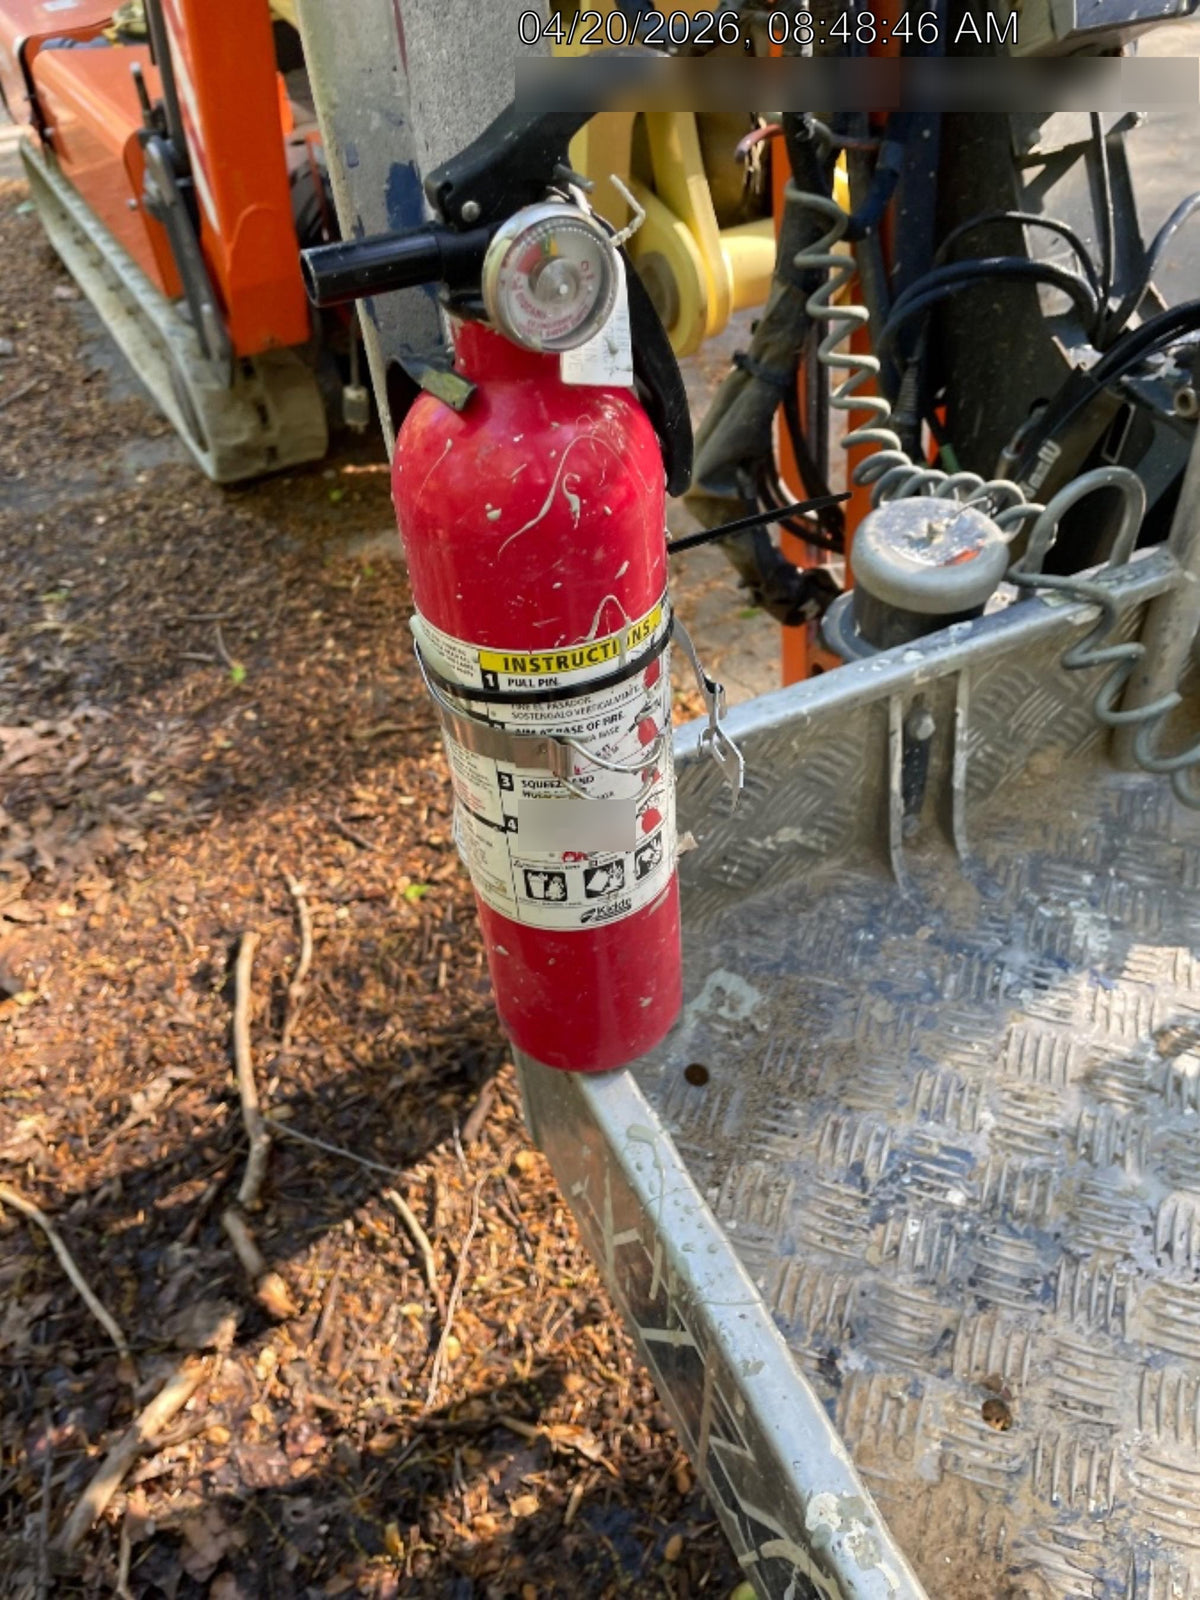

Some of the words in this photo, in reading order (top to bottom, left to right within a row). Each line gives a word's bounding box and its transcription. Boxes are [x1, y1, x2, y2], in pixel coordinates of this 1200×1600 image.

[503, 619, 650, 673] INSTRUCTINS
[507, 678, 535, 688] PULL
[587, 719, 600, 732] OF
[502, 776, 511, 787] 3
[521, 779, 567, 790] SQUEEZ
[507, 818, 516, 831] 4
